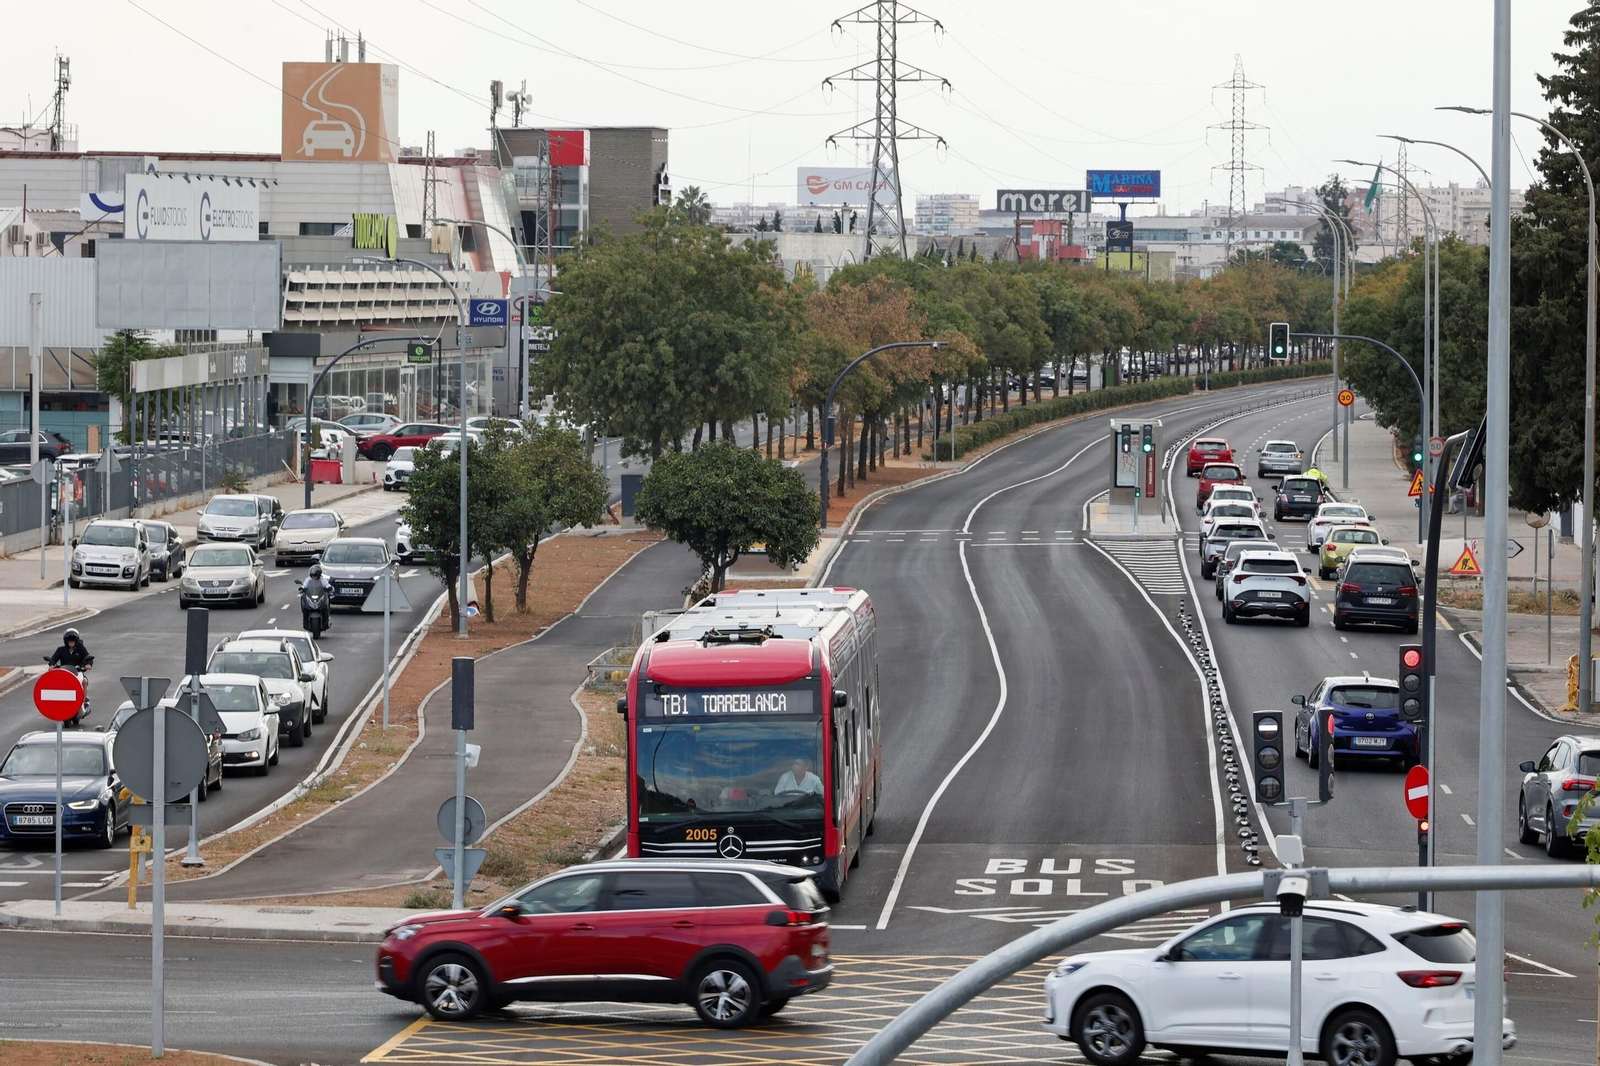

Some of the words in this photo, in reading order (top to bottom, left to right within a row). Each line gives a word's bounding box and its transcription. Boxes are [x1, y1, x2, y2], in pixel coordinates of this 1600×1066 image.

[833, 181, 853, 190] GM
[856, 181, 887, 191] CAH
[1092, 173, 1154, 193] MARINA
[1000, 191, 1087, 212] marel
[150, 207, 187, 226] FLUIDSTOCKS
[212, 209, 254, 228] ELECTROSTOCKS
[661, 694, 689, 716] TB1
[702, 693, 787, 713] TORREBLANCA
[18, 816, 36, 824] 8785
[38, 816, 52, 824] LCG
[685, 828, 718, 841] 2005
[984, 858, 1136, 875] BUS
[954, 878, 1166, 897] SOLO
